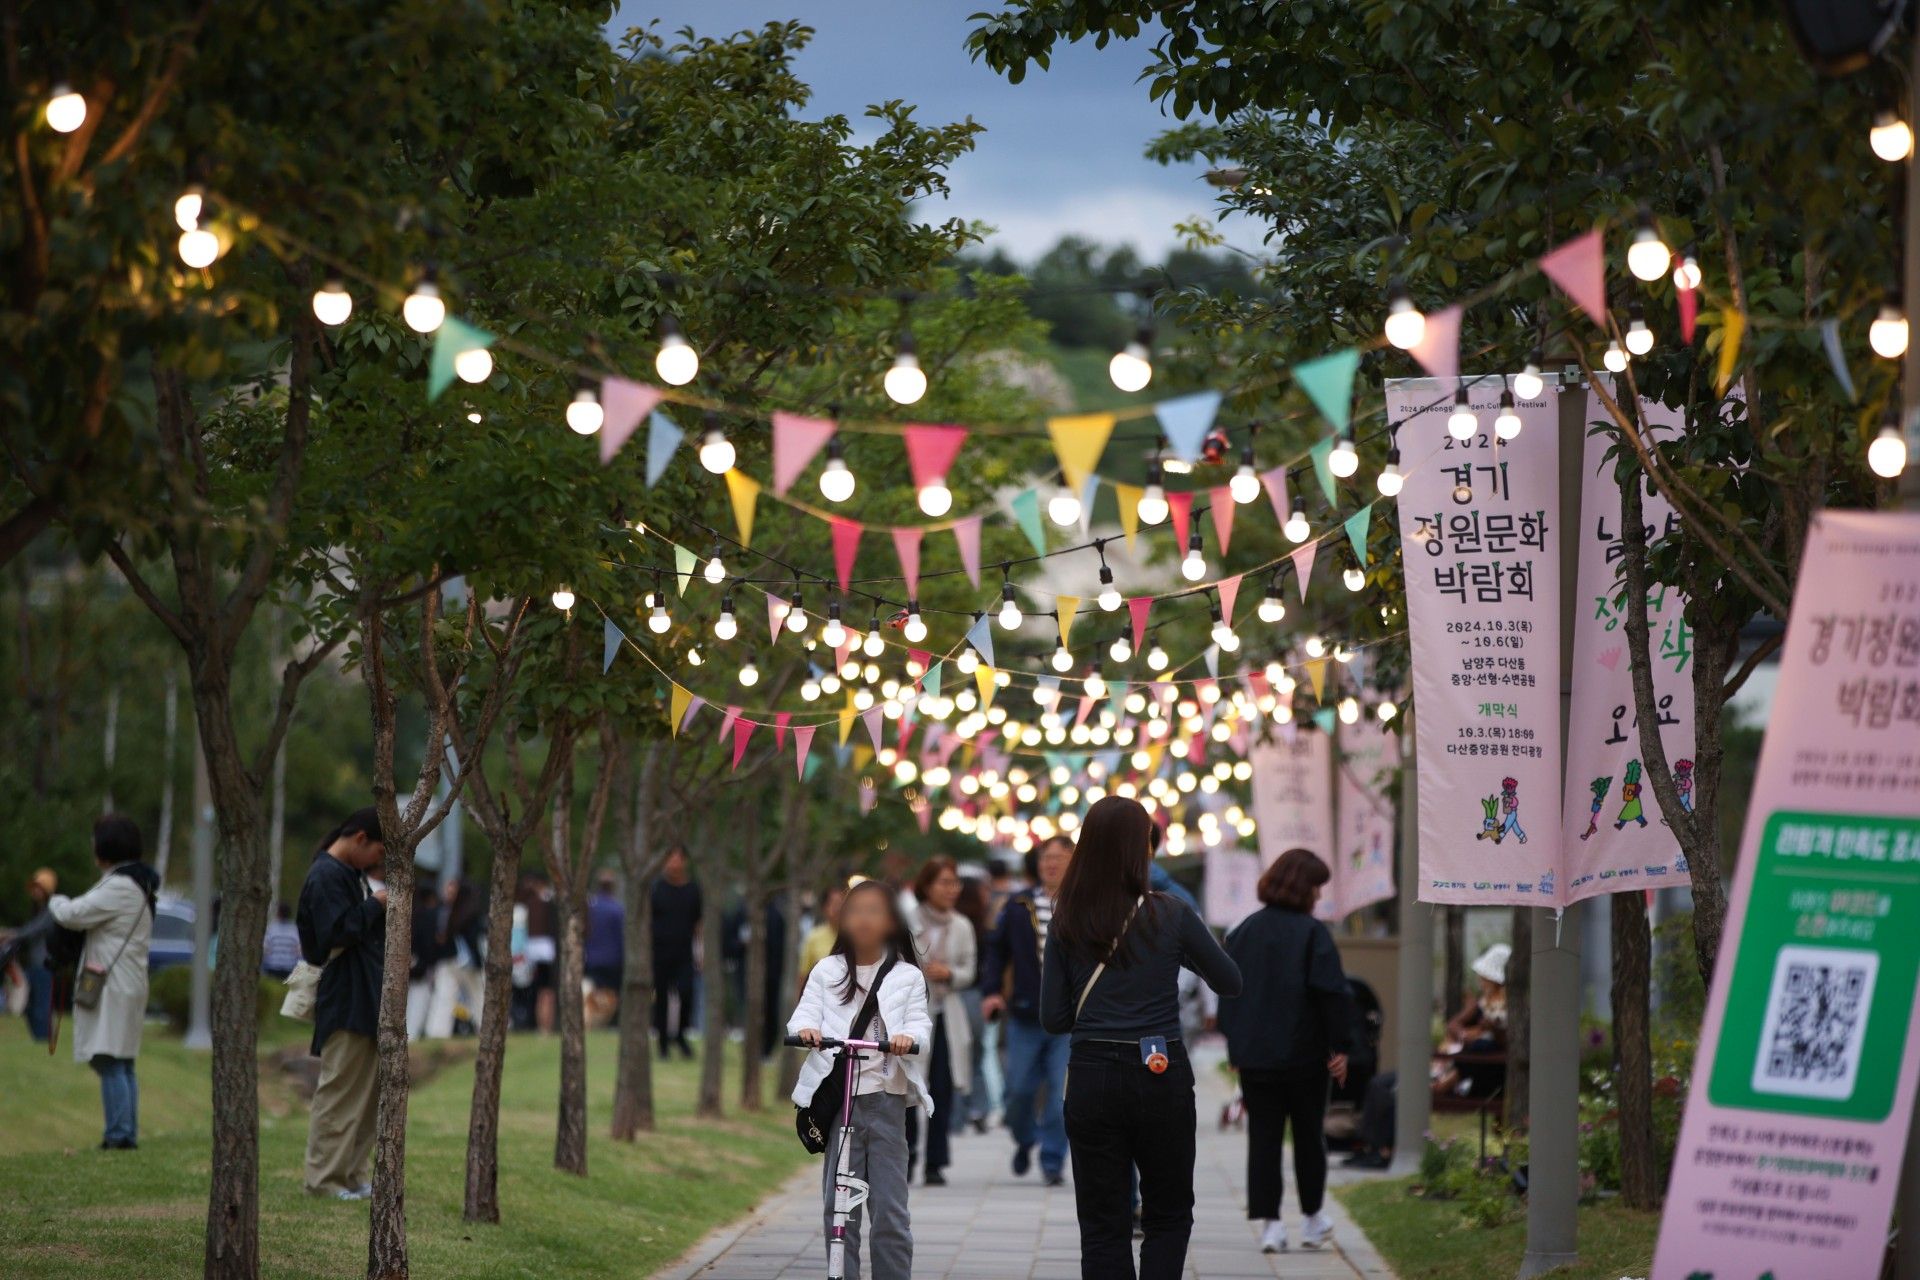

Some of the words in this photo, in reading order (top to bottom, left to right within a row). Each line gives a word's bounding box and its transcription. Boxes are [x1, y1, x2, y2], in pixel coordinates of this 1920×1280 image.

[1444, 434, 1508, 449] 2024
[1441, 462, 1509, 505] 경기
[1414, 510, 1549, 556] 정원문화
[1434, 561, 1534, 604] 박람회
[1446, 621, 1533, 633] 2024.10.3(목)
[1474, 637, 1524, 648] 10.6(일)
[1462, 657, 1495, 670] 남양주
[1498, 657, 1526, 670] 다산동
[1451, 673, 1536, 687] 중앙·선형·수변공원
[1478, 703, 1518, 718] 개막식
[1458, 728, 1506, 738] 10.3.(목)
[1508, 729, 1534, 739] 18:00
[1447, 744, 1509, 756] 다산중앙공원
[1511, 745, 1543, 758] 잔디광장
